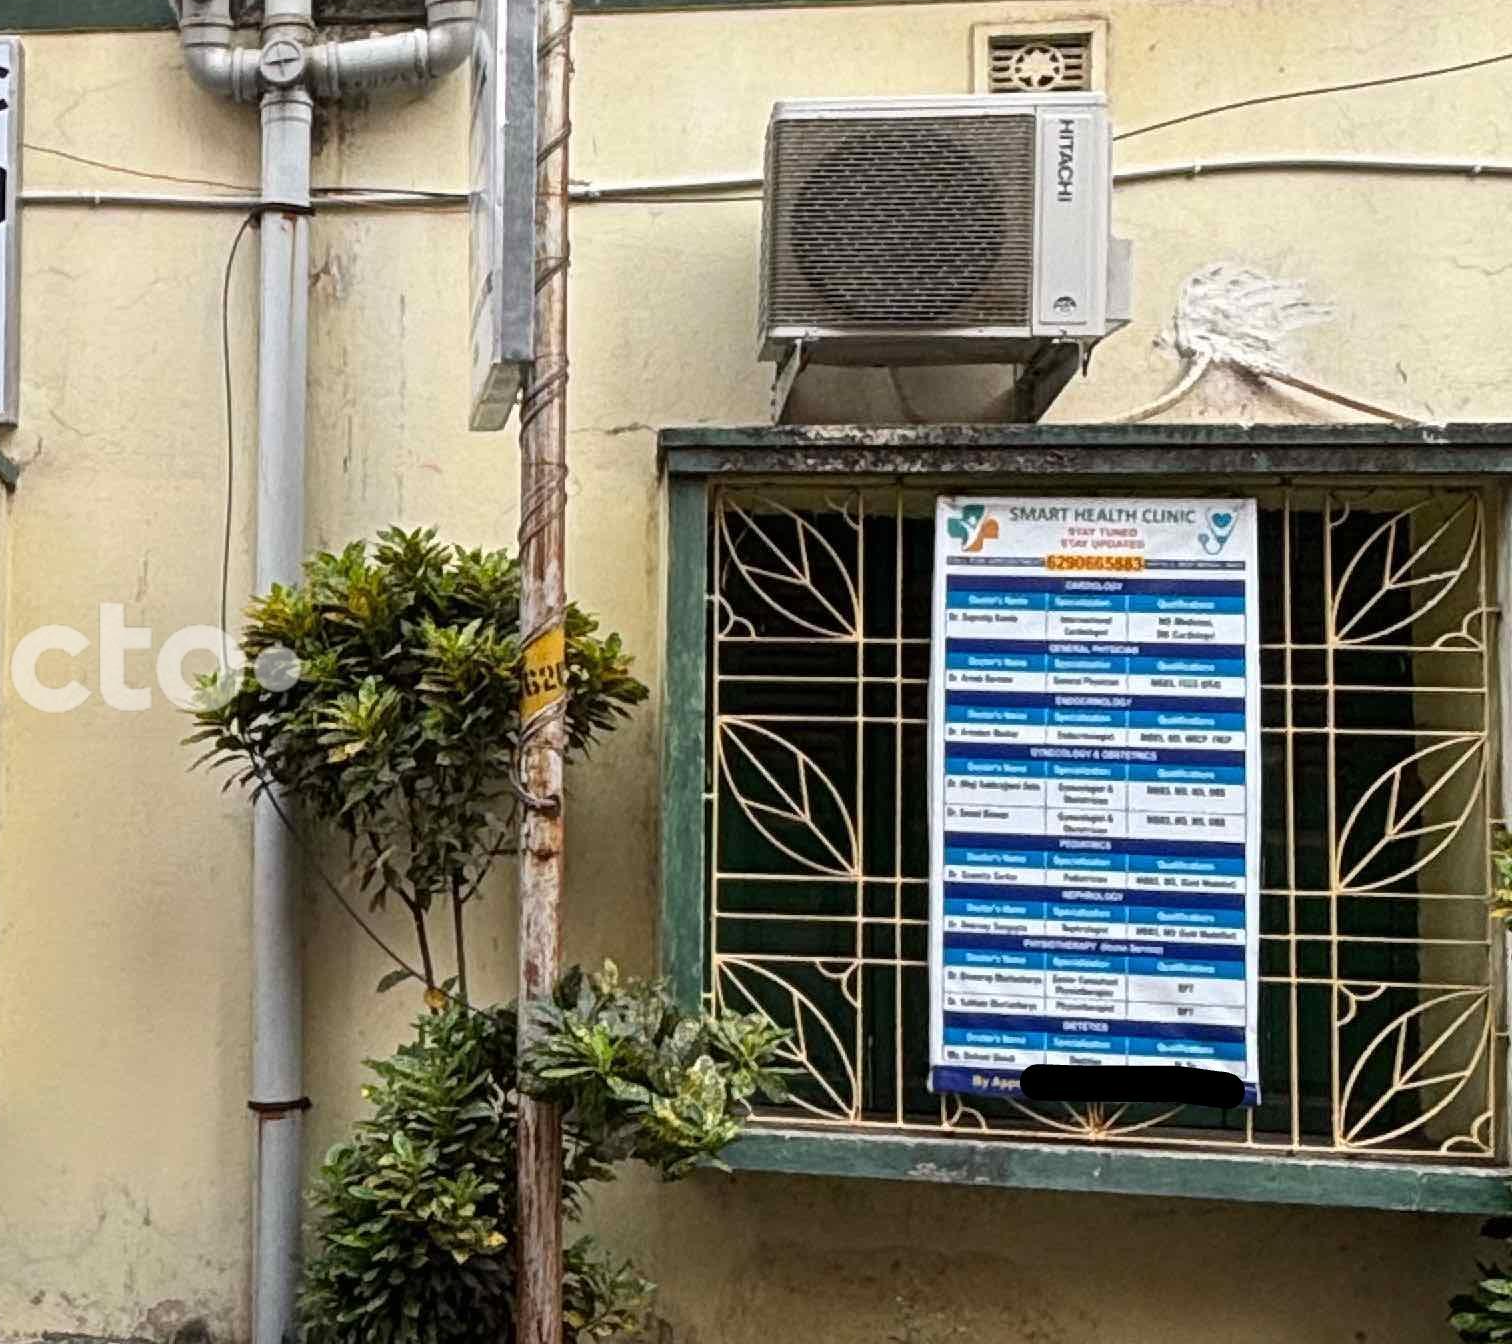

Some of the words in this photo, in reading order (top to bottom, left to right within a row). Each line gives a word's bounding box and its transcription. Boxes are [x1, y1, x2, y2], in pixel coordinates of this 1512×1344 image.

[1057, 119, 1075, 202] HITACHI
[1009, 507, 1069, 522] SMART
[1074, 508, 1138, 524] HEALTH
[1142, 509, 1196, 524] CLINIC
